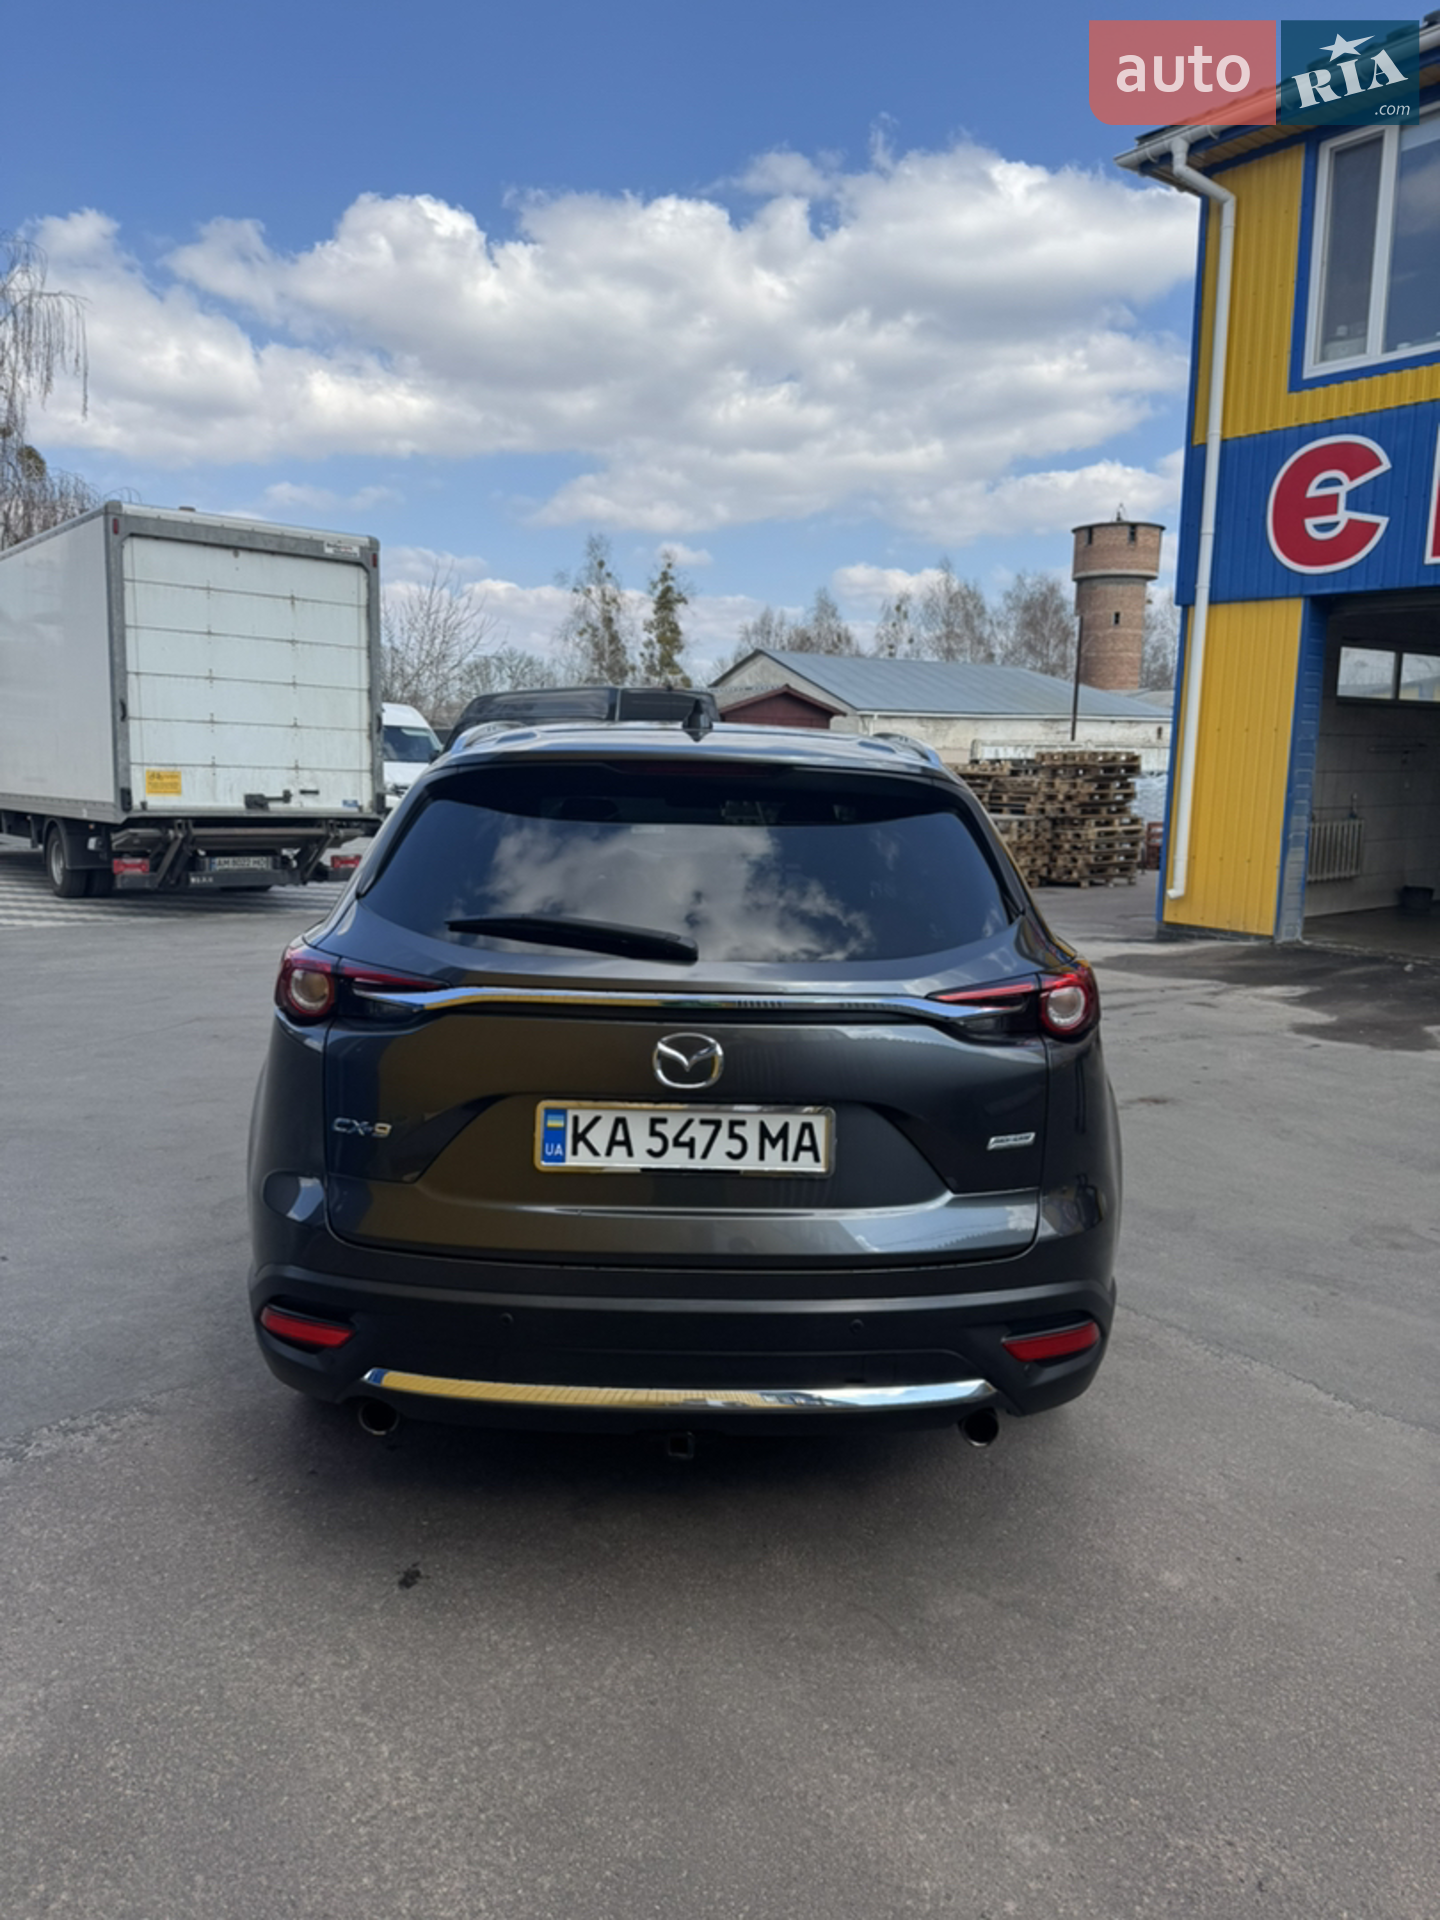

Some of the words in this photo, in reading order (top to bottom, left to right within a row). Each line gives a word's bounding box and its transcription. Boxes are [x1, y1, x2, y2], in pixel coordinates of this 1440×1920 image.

[333, 1117, 393, 1138] CX-9
[544, 1143, 563, 1156] UA
[570, 1115, 634, 1158] KA
[646, 1117, 749, 1161] 5475
[758, 1119, 821, 1164] MA
